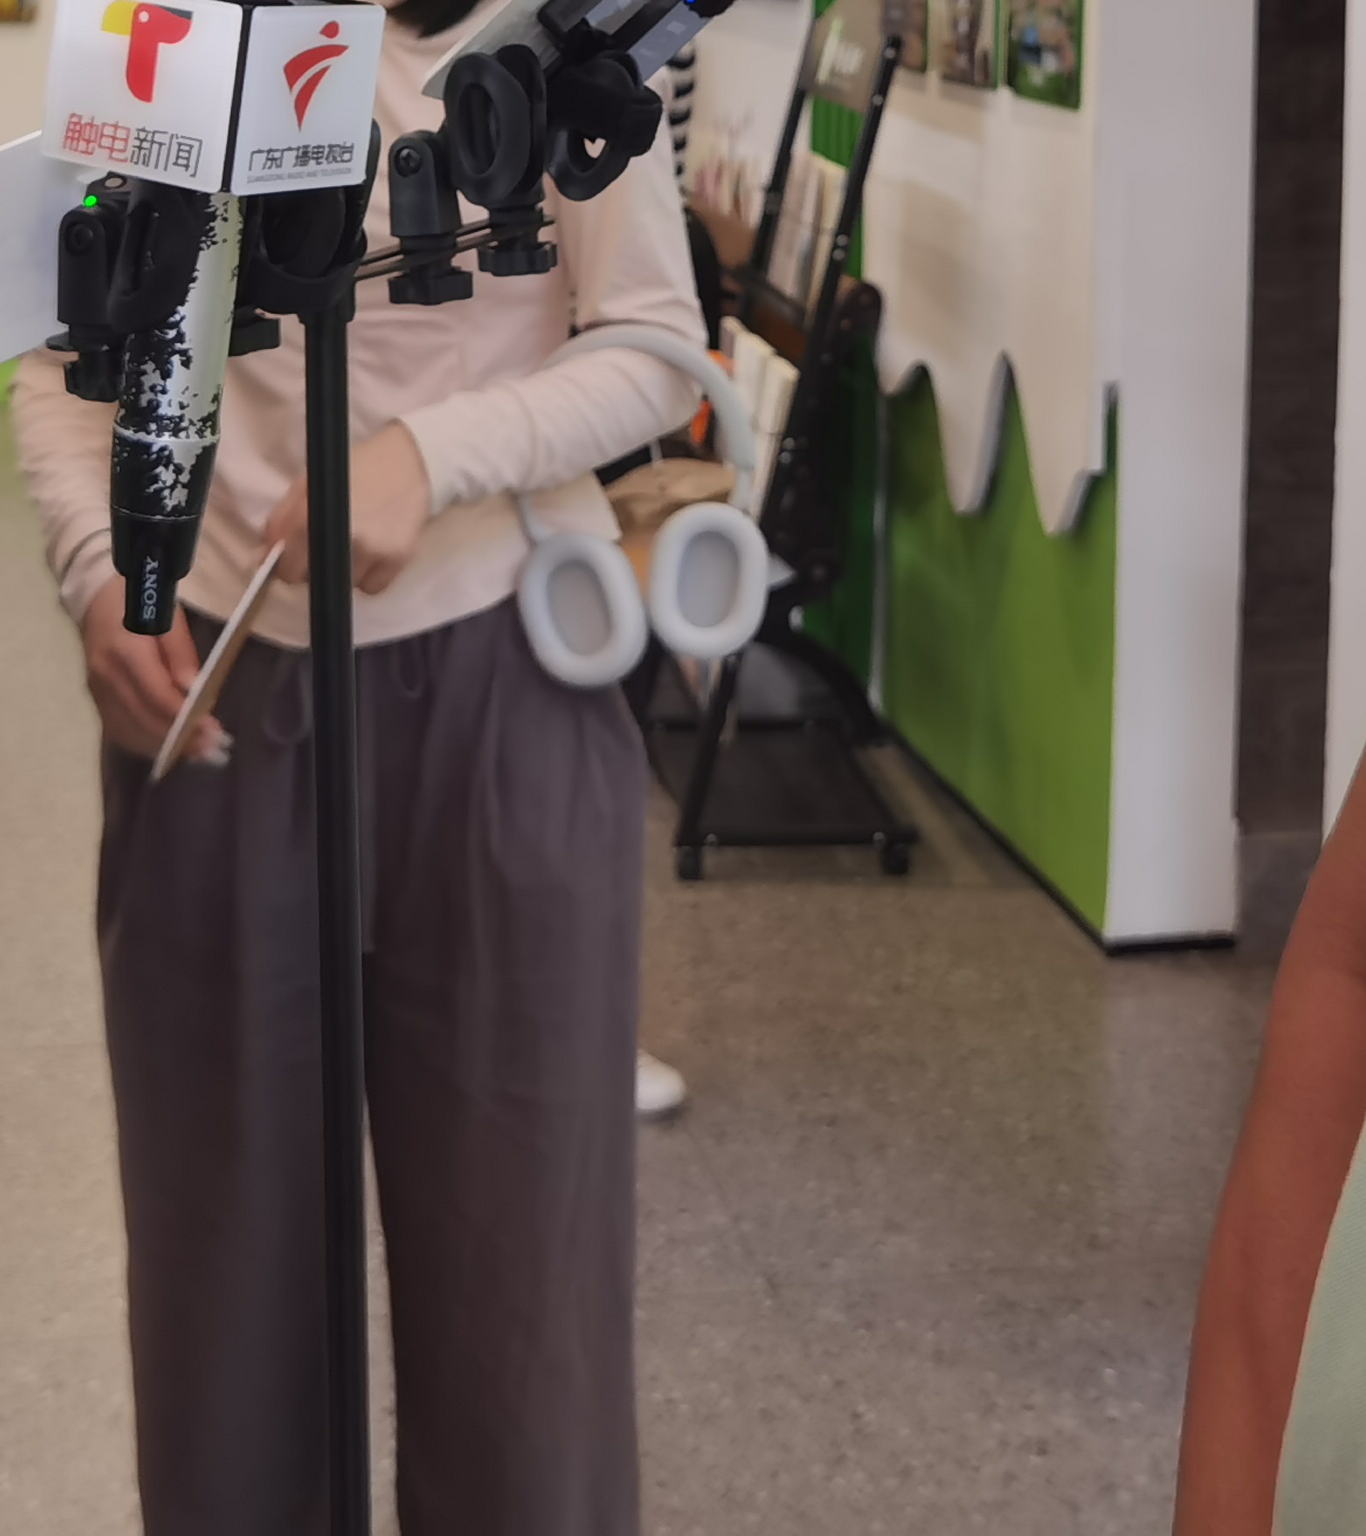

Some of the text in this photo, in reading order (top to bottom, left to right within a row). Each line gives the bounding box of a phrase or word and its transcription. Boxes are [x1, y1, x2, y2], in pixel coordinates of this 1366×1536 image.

[62, 112, 203, 178] 触电新闻
[248, 141, 355, 171] 广东广播电视台
[143, 556, 160, 620] SONY
